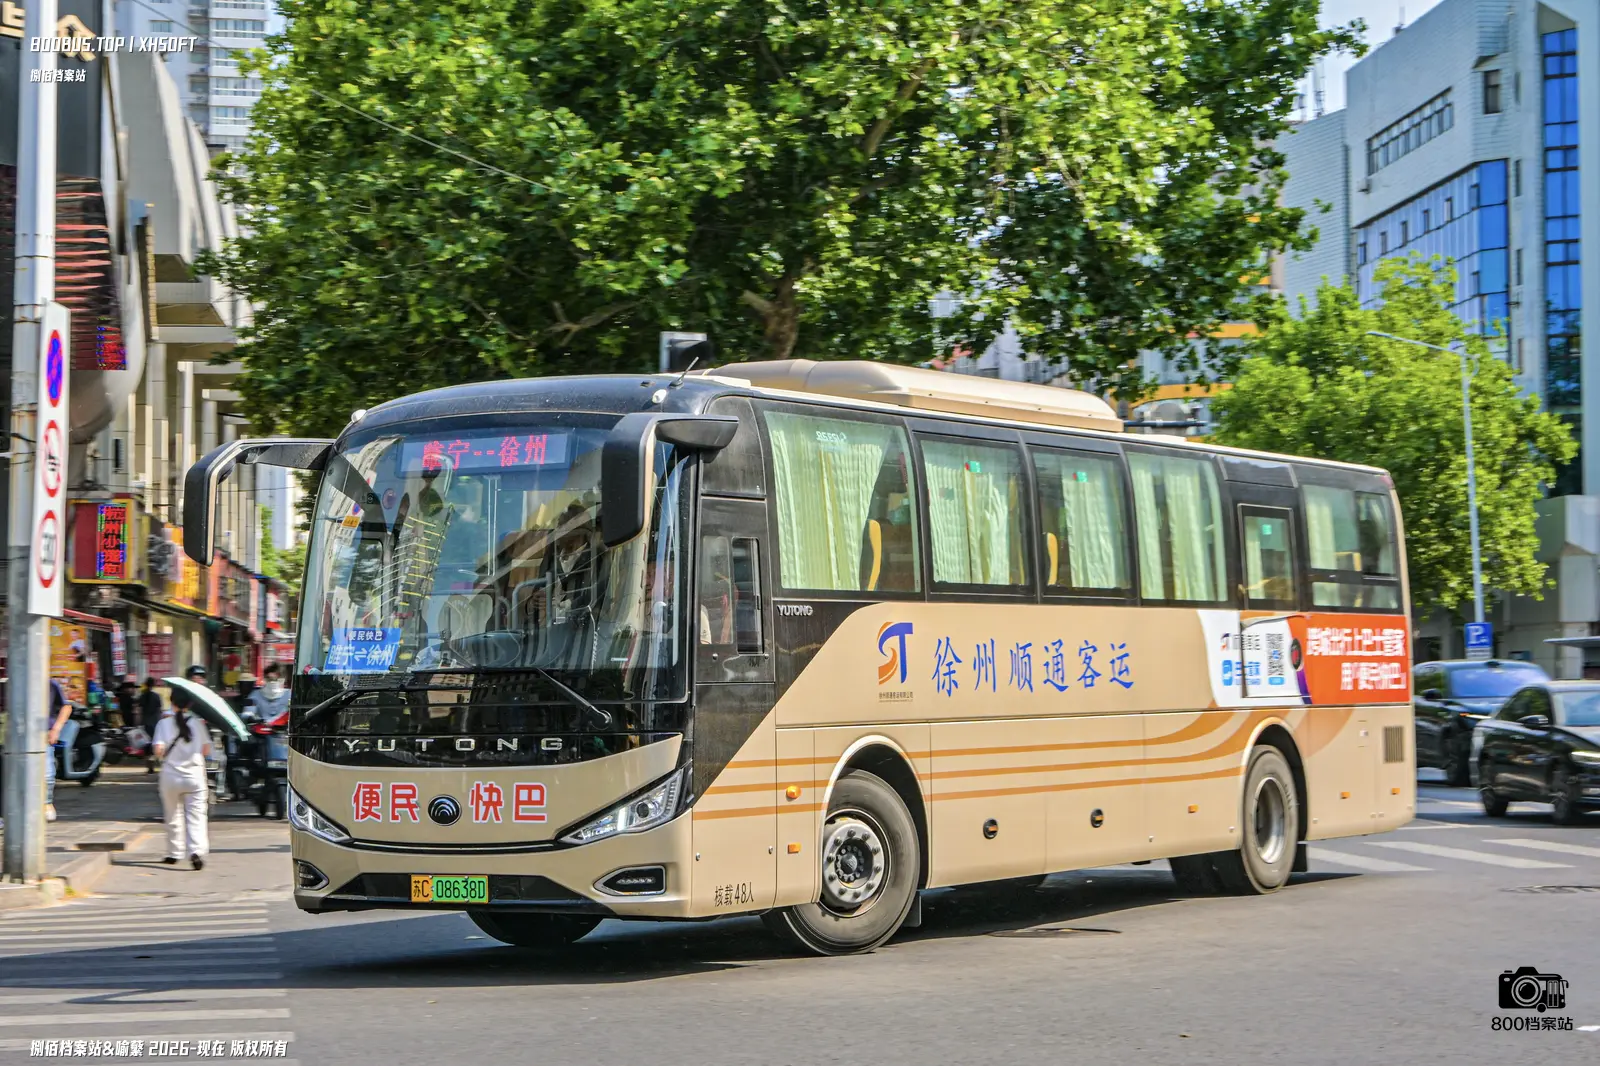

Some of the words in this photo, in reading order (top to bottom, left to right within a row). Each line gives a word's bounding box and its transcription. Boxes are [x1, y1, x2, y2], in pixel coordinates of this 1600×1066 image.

[776, 604, 814, 617] YUTONG
[931, 636, 1135, 698] 徐州顺通客运
[343, 737, 564, 752] YUTONG
